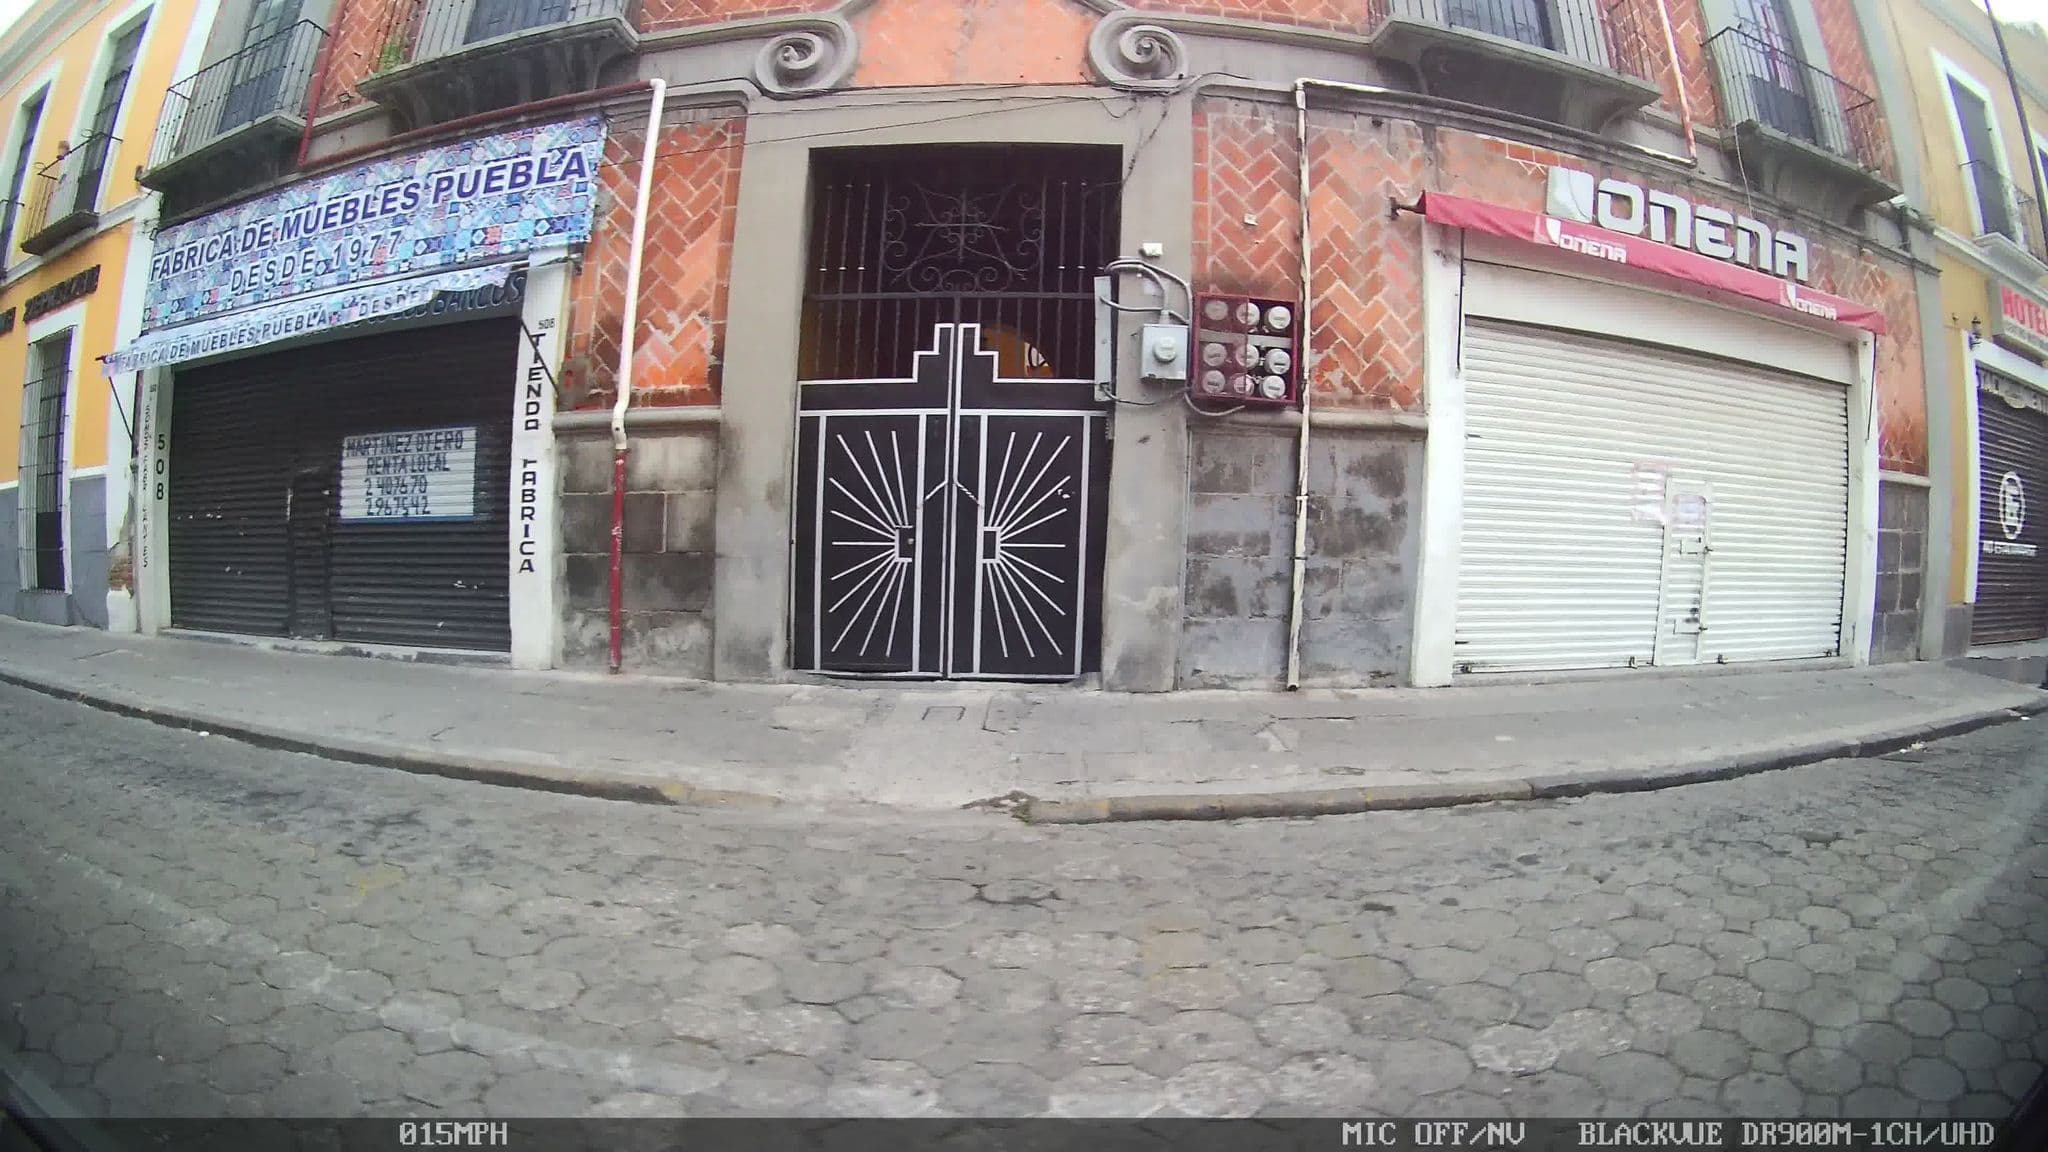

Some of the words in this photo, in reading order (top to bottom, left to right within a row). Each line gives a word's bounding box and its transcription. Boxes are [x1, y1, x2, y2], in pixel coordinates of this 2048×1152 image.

[150, 233, 233, 281] FABRICA
[240, 221, 274, 252] DE
[279, 181, 421, 241] MUEBLES
[432, 150, 587, 204] PUEBLA
[231, 249, 315, 293] DESDE
[333, 230, 401, 266] 1977
[120, 345, 166, 370] FABRICA
[170, 342, 188, 360] DE
[191, 328, 255, 354] MUEBLES
[261, 308, 327, 338] PUEBLA
[156, 434, 165, 500] 508
[346, 433, 412, 457] MARTINEZ
[416, 430, 464, 450] OTERO
[366, 455, 407, 475] RENTA
[410, 452, 450, 472] LOCAL
